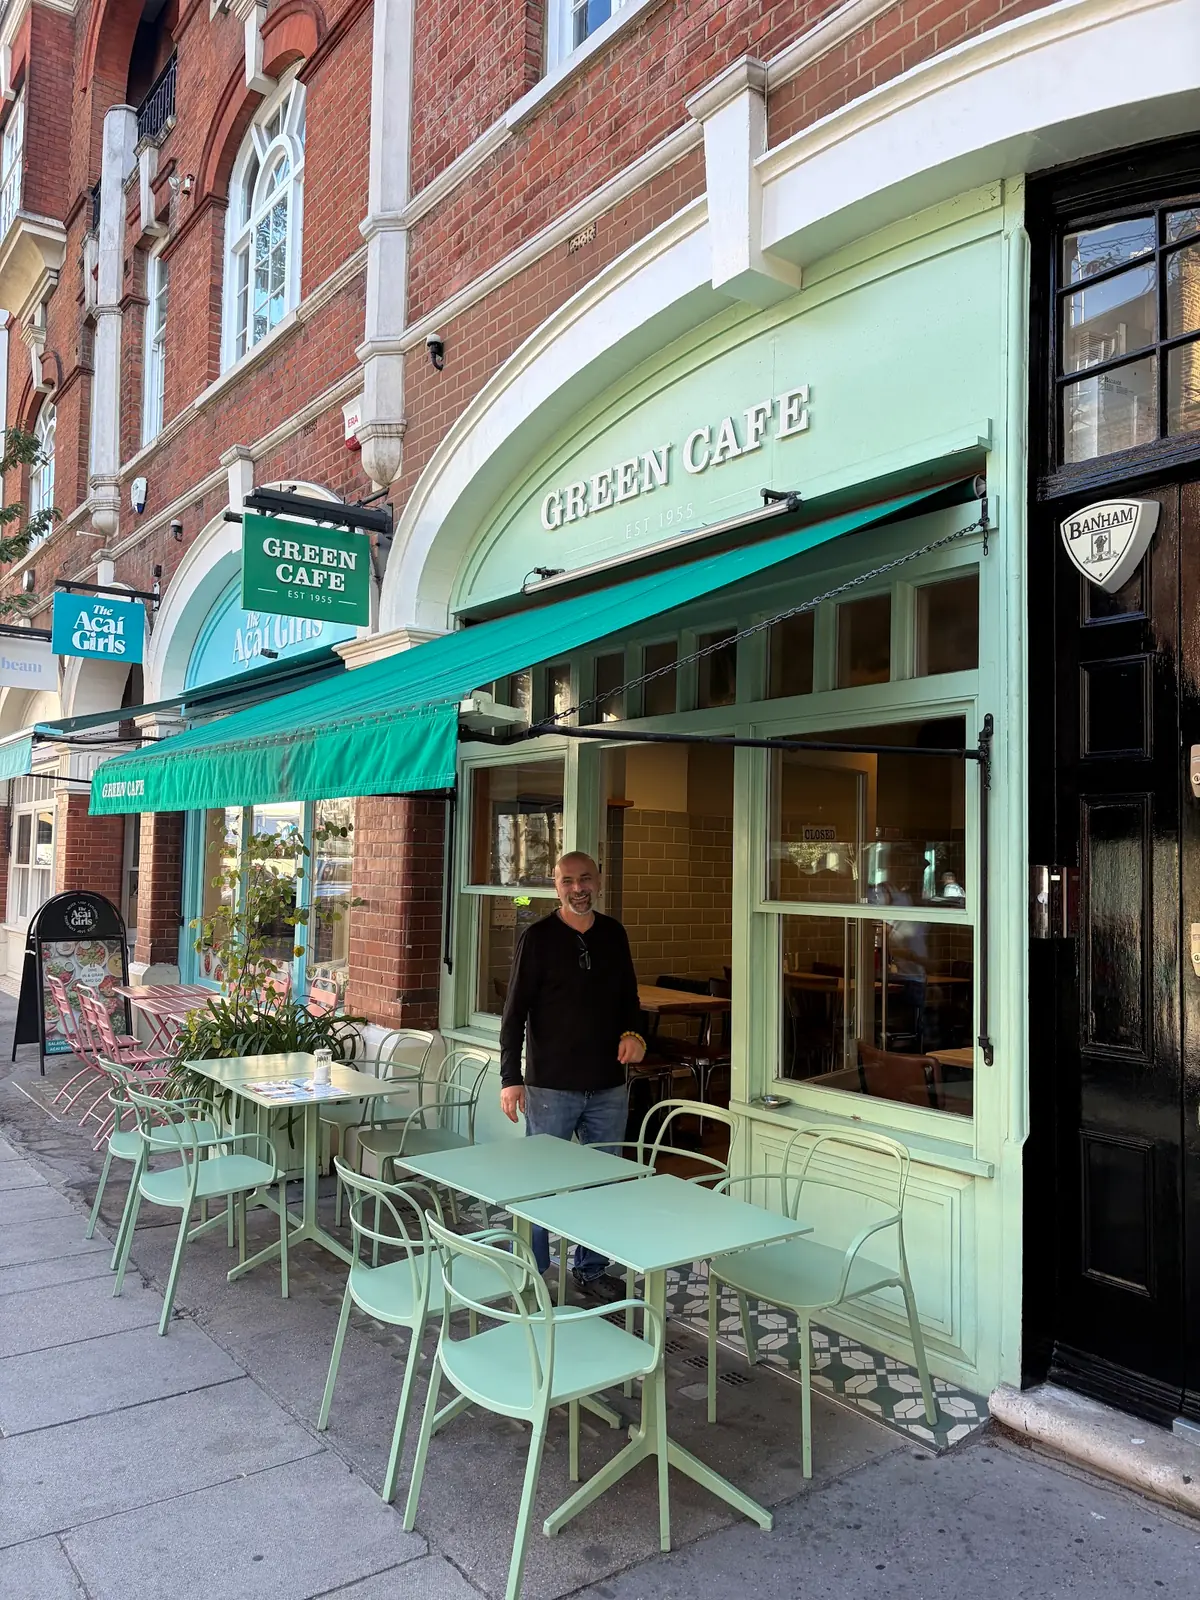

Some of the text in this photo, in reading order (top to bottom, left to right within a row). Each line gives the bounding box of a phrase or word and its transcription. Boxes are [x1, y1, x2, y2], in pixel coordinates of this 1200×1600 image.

[348, 415, 358, 428] ERA
[540, 384, 810, 531] GREEN CAFE
[626, 503, 693, 539] EST 1955
[1069, 508, 1133, 540] BANHAM
[262, 537, 358, 570] GREEN
[276, 564, 345, 591] CAFE
[288, 590, 332, 604] EST 1955
[92, 604, 114, 616] The
[72, 630, 126, 654] Girls
[1, 657, 42, 673] beam
[102, 780, 145, 798] GREEN CAFE
[804, 829, 835, 840] CLOSED
[71, 917, 92, 925] Girls
